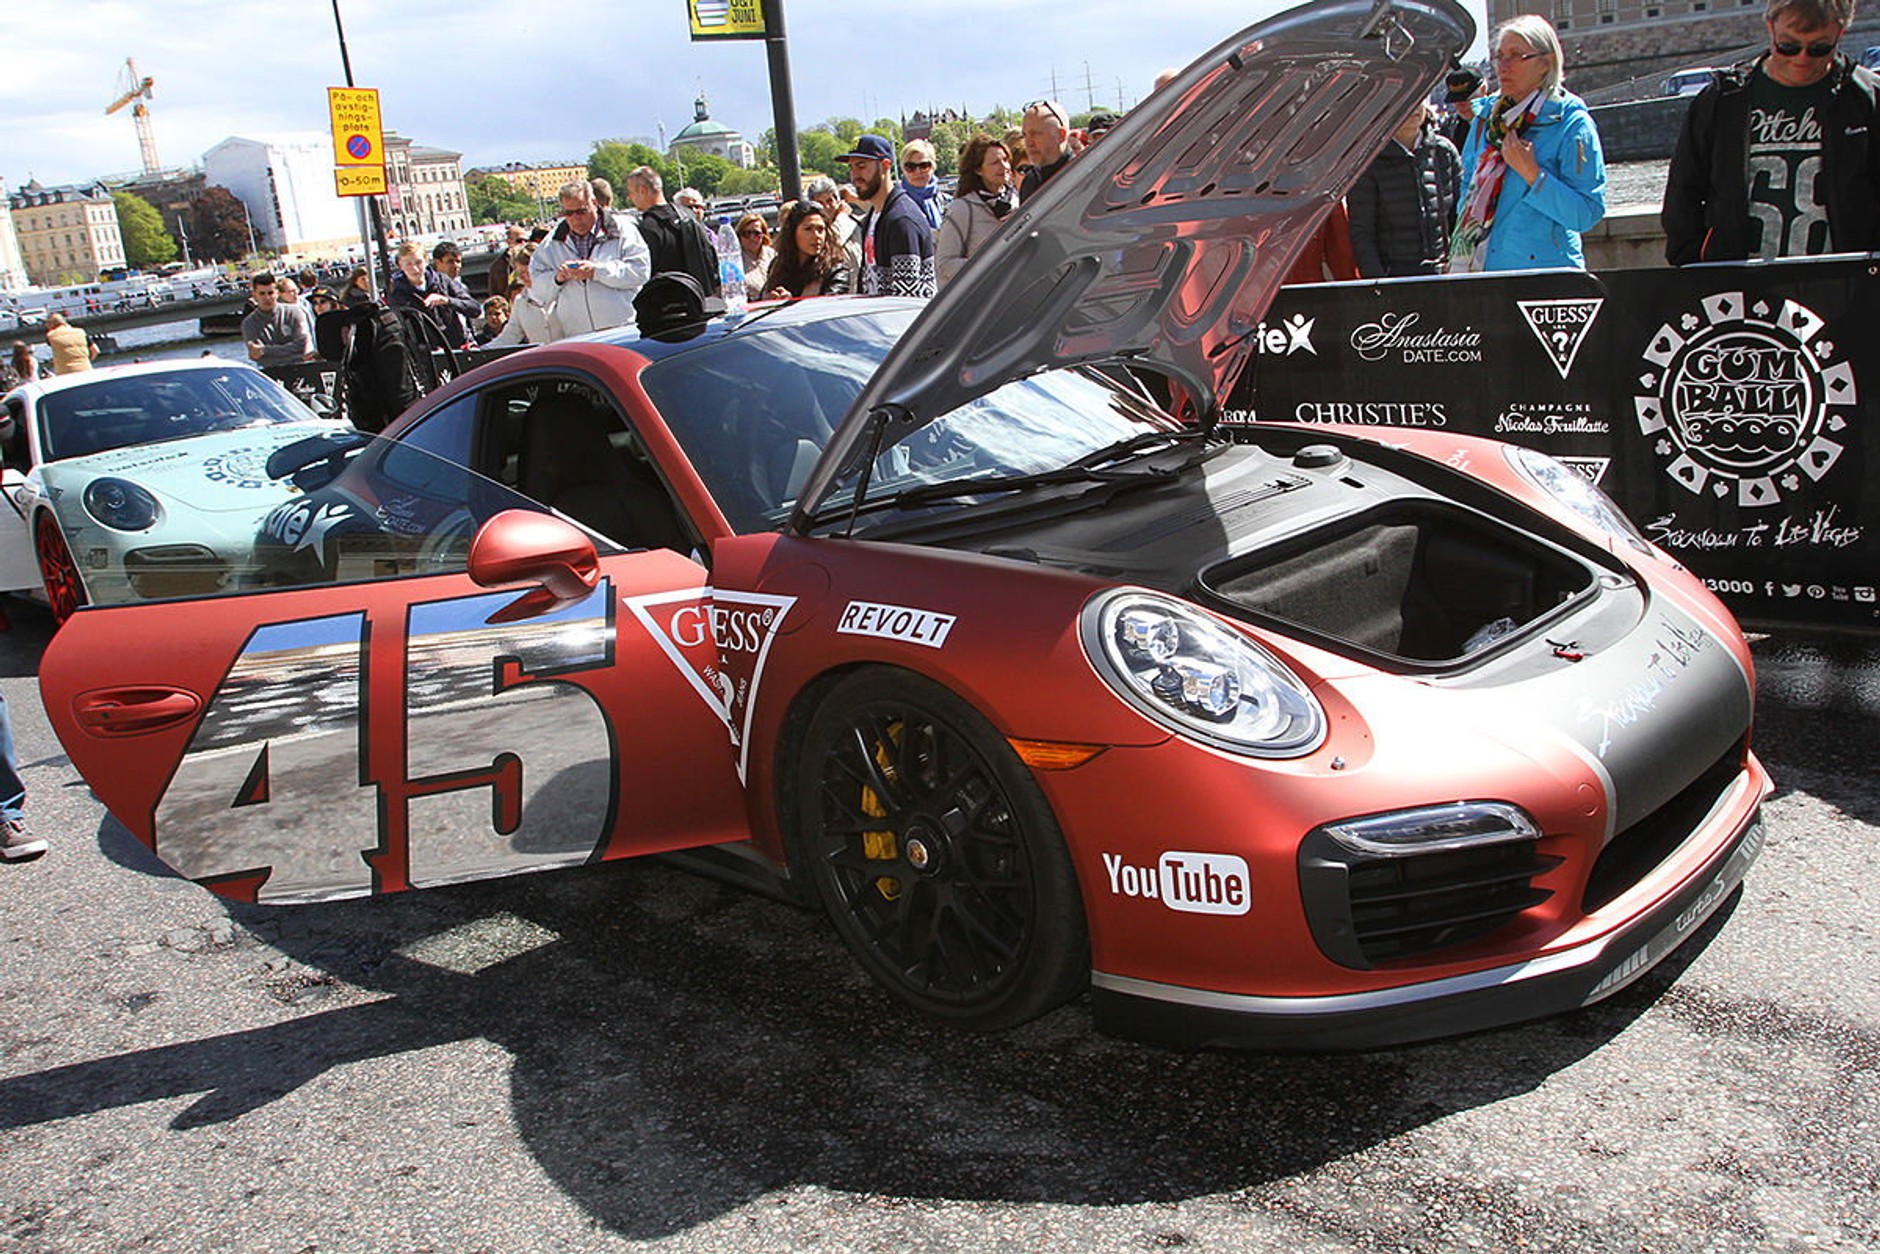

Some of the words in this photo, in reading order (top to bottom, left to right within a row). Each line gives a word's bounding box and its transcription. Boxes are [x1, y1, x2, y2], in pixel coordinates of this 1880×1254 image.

[356, 93, 375, 101] och
[335, 103, 374, 113] avstig-
[338, 112, 372, 122] nings-
[342, 123, 370, 132] plats
[1350, 311, 1482, 362] Anastasia
[1403, 349, 1483, 364] DATE.COM
[1509, 402, 1592, 413] CHAMPAGNE
[1679, 382, 1802, 416] BALL
[1294, 402, 1448, 427] CHRISTIE'S
[1494, 411, 1544, 434] Nicolas
[841, 604, 950, 642] REVOLT
[1102, 851, 1245, 906] YouTube
